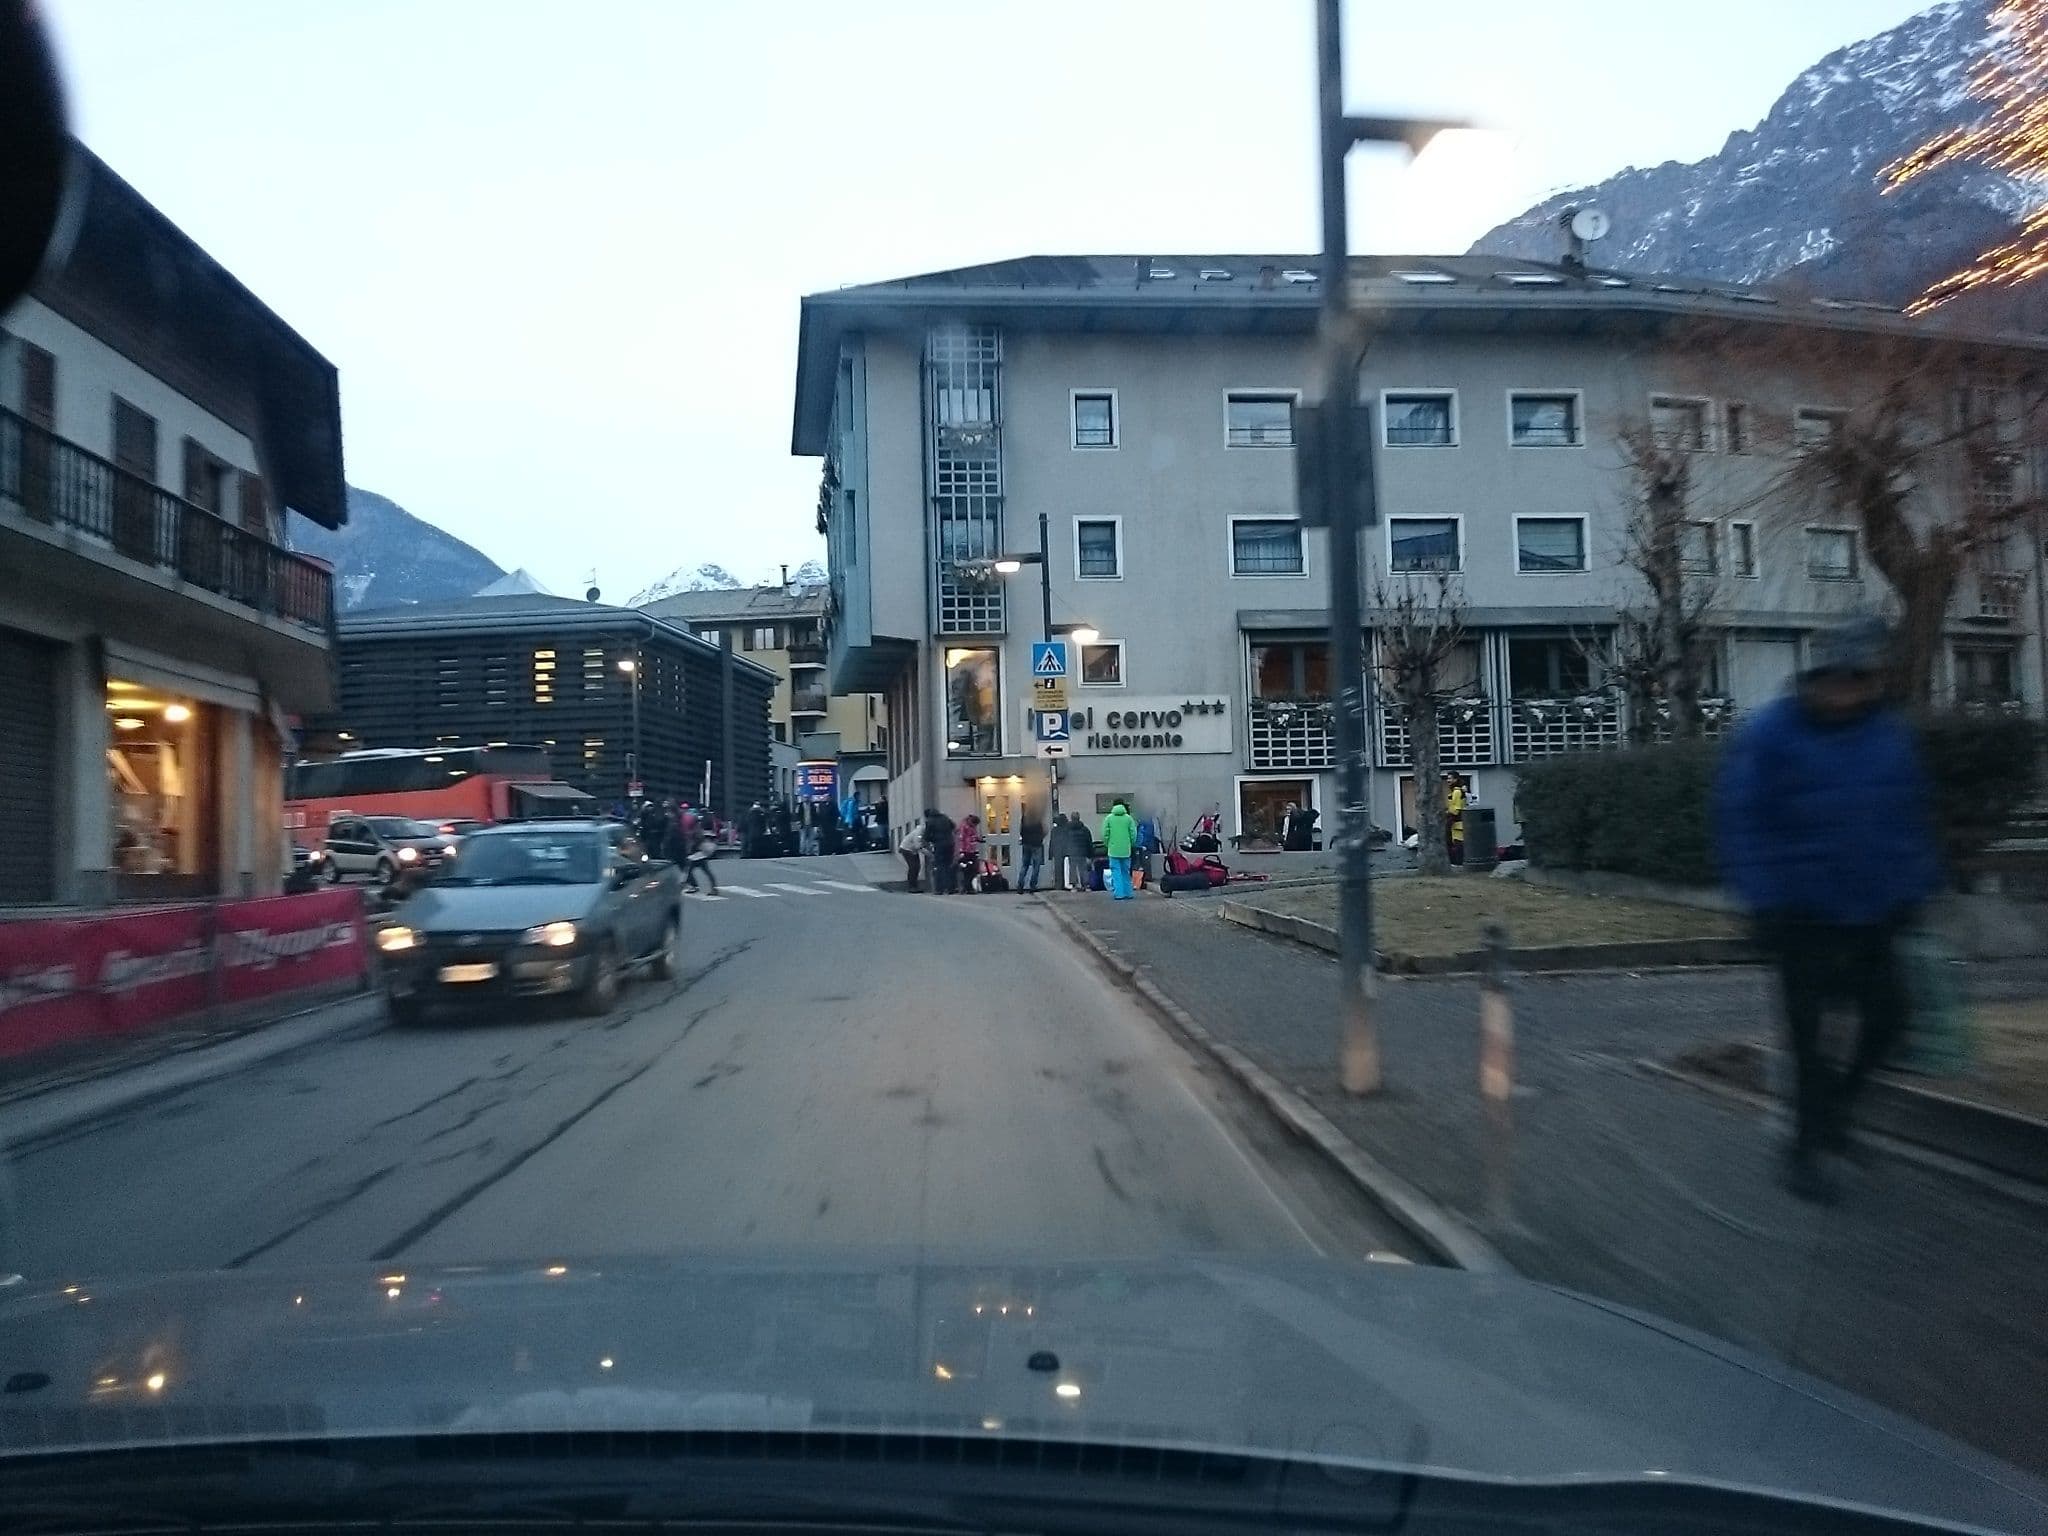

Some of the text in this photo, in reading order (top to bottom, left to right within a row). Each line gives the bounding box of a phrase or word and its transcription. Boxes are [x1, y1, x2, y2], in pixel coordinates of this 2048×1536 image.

[1042, 713, 1062, 737] P
[1106, 710, 1182, 729] cervo
[1087, 732, 1183, 749] ristorante
